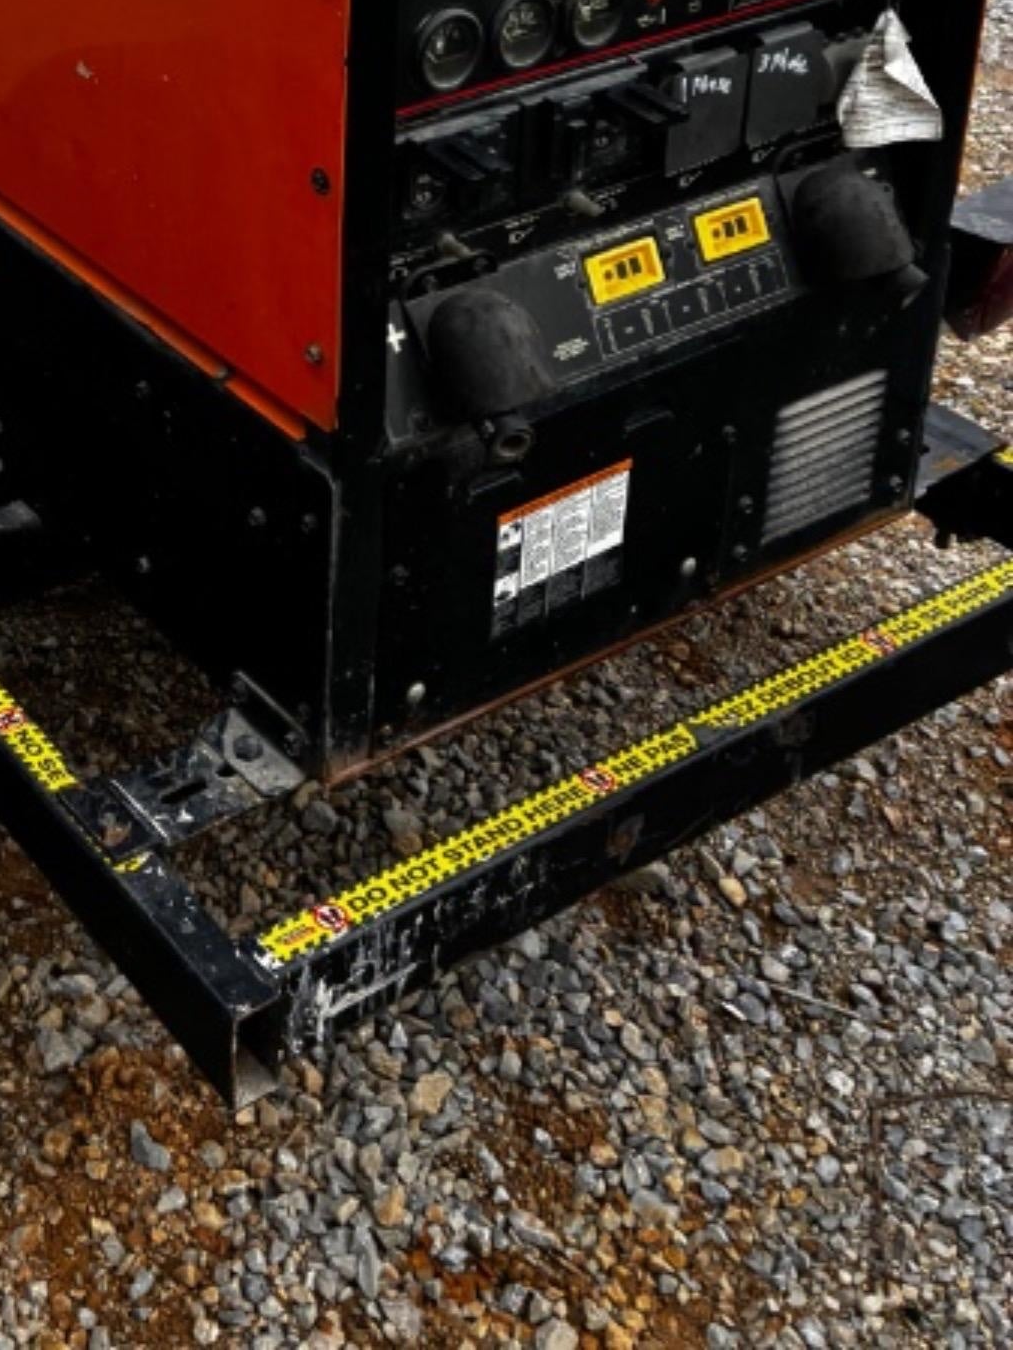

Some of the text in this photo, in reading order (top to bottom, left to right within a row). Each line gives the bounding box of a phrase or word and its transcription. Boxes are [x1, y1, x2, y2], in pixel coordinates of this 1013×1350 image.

[14, 730, 43, 757] NO
[346, 885, 388, 913] DO
[390, 855, 439, 893] NOT
[442, 816, 524, 864] STAND
[524, 783, 588, 822] HERE
[645, 734, 691, 760] PAS
